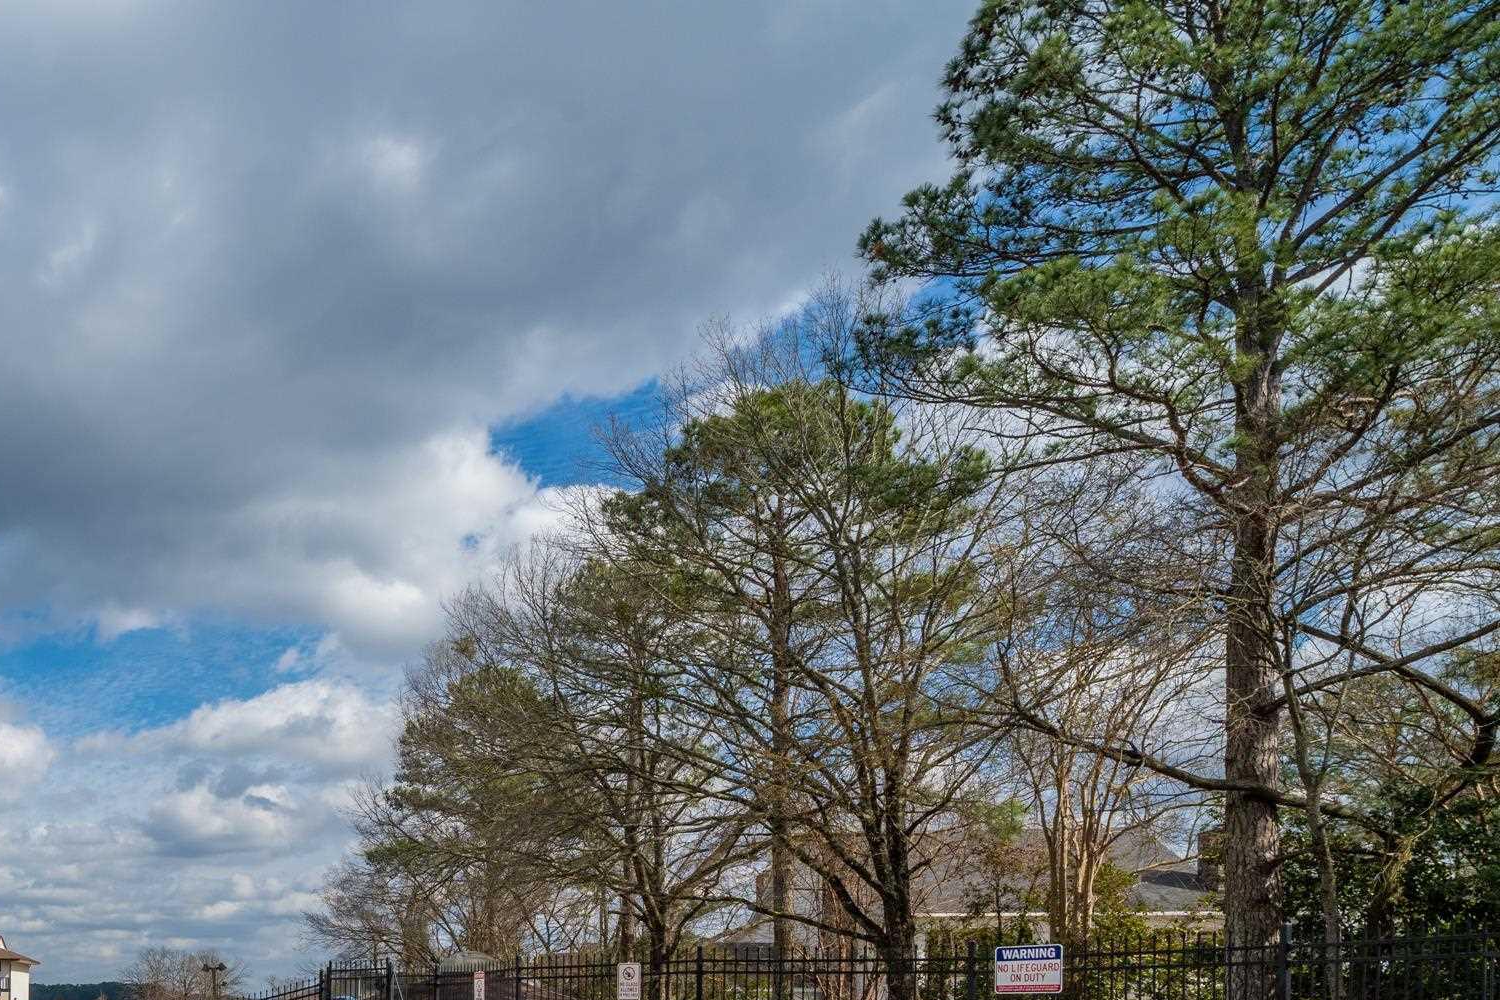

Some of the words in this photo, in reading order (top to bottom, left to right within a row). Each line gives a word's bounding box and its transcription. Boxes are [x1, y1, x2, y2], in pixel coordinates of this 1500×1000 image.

[1002, 947, 1056, 960] WARNING
[997, 964, 1009, 973] NO
[1011, 962, 1060, 973] LIFEGUARD
[1010, 973, 1022, 982] ON
[1024, 972, 1046, 982] DUTY
